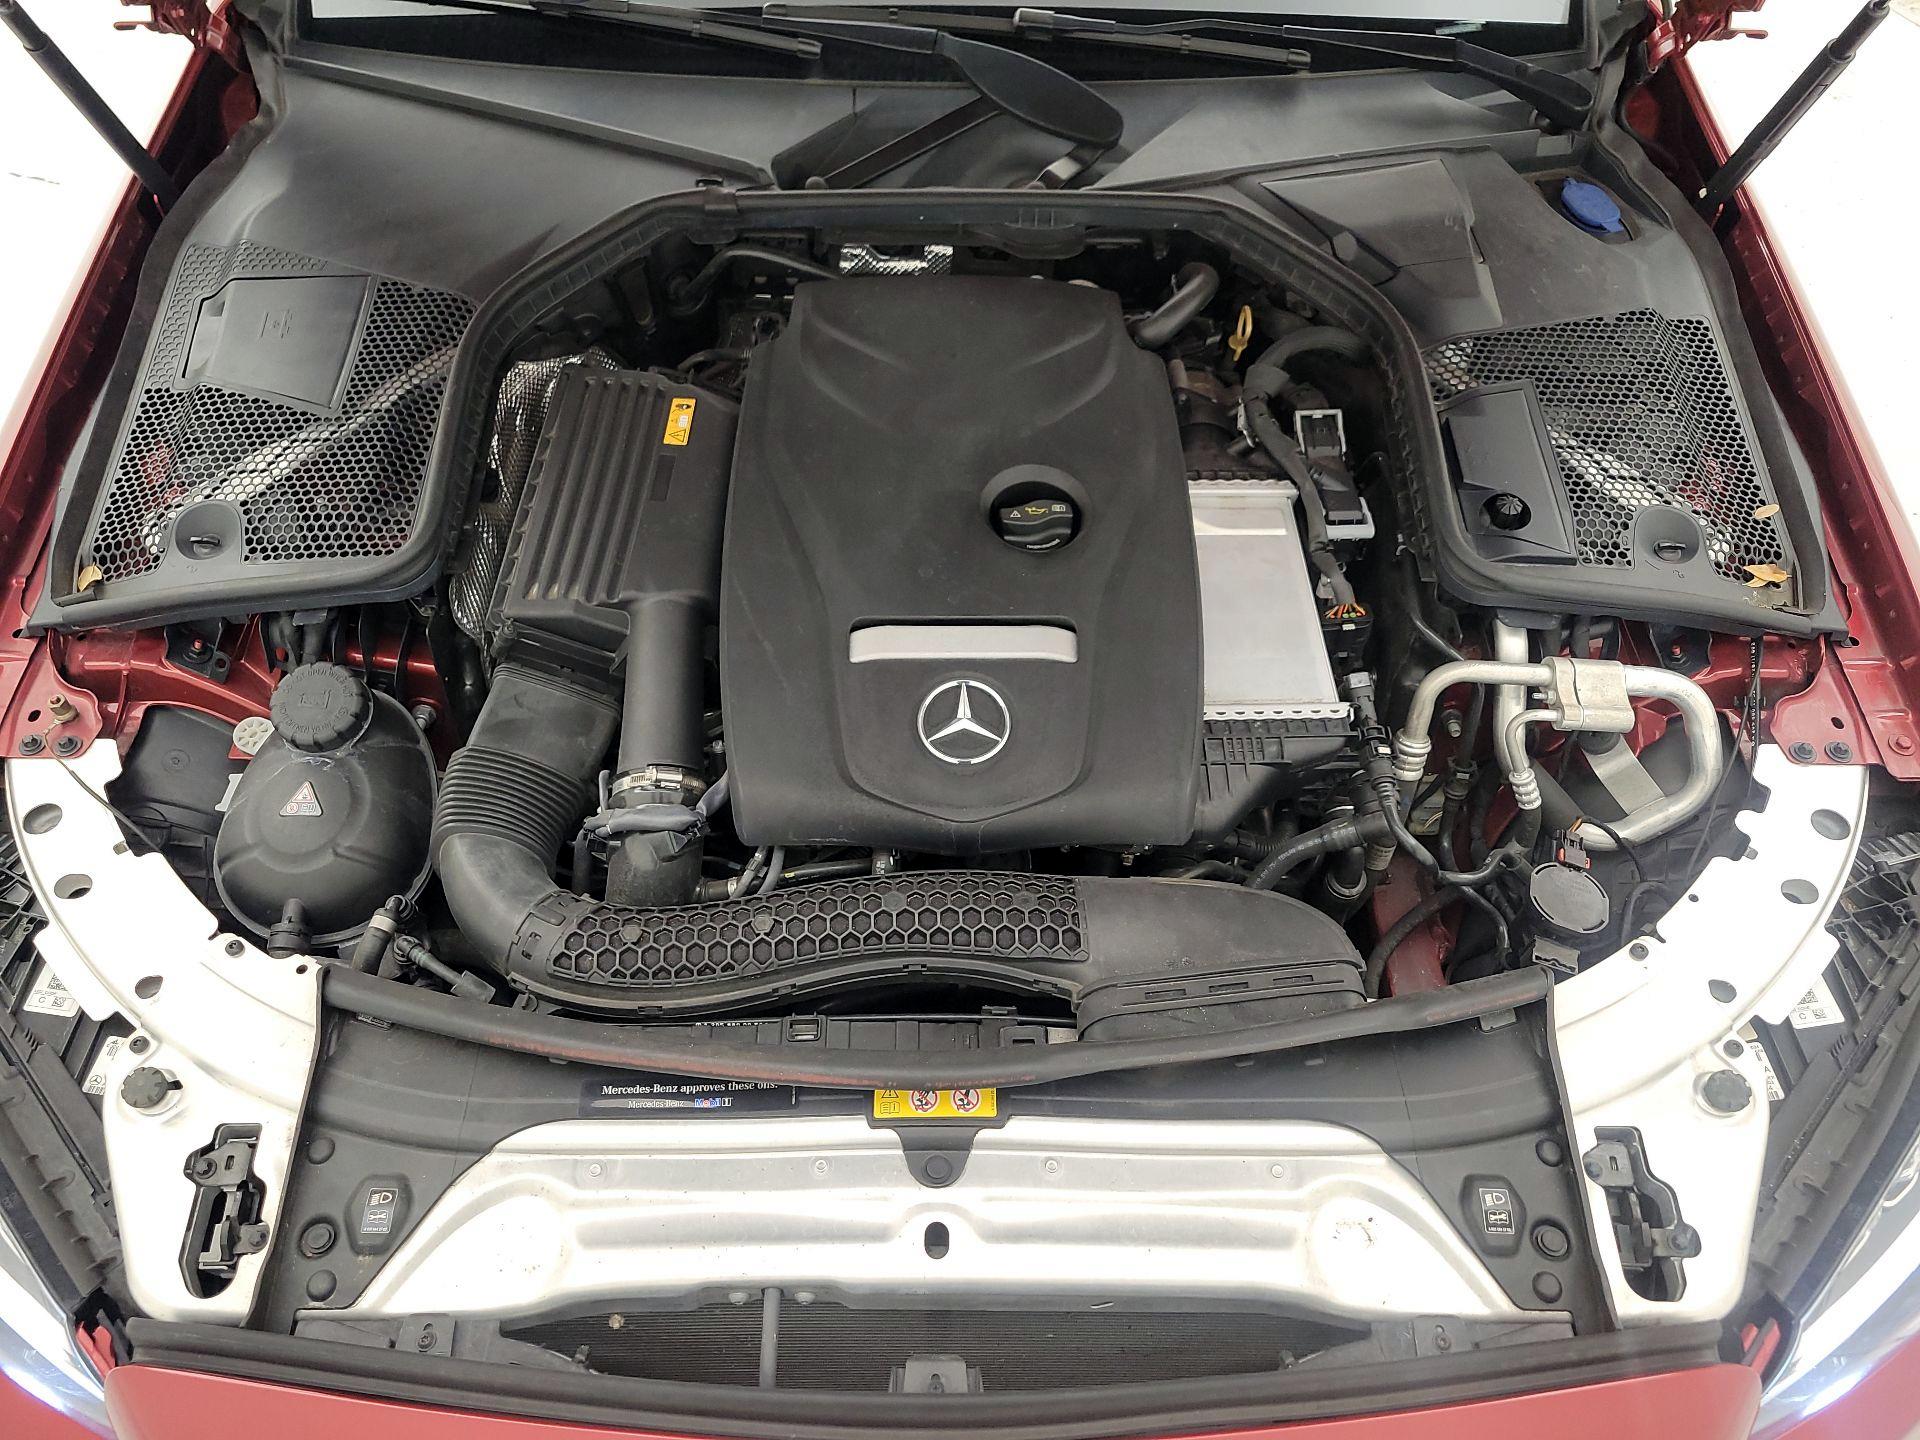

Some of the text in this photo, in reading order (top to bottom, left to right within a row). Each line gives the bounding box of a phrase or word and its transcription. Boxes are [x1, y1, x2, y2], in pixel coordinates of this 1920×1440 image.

[601, 1083, 678, 1095] Mercedes-Benz
[680, 1082, 726, 1094] approves
[728, 1081, 755, 1091] these
[628, 1100, 684, 1109] Mercedes-Benz
[694, 1098, 721, 1107] Mobil
